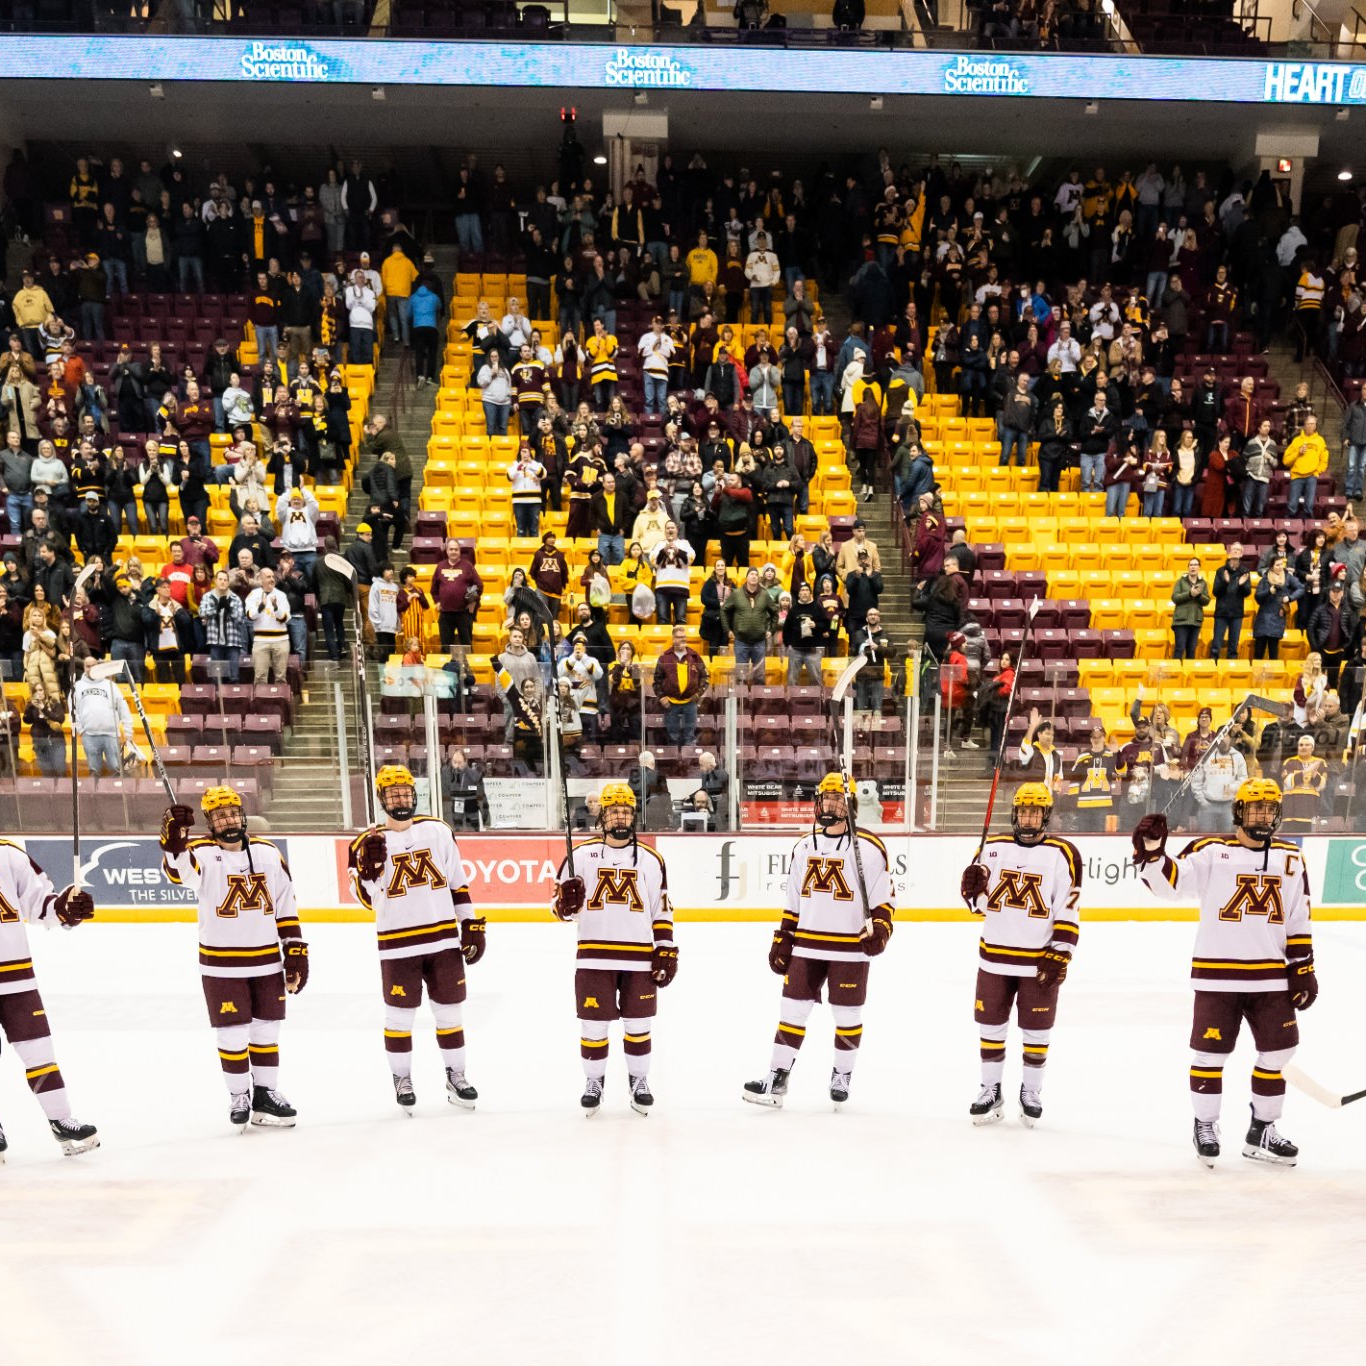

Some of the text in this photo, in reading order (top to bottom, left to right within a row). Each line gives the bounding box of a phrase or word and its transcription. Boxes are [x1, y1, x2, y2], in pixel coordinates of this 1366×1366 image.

[252, 42, 307, 62] Boston
[617, 49, 671, 69] Boston
[241, 54, 329, 79] Scientific
[605, 60, 691, 86] Scientific
[957, 57, 1010, 76] Boston
[944, 69, 1029, 94] Scientific
[1264, 63, 1348, 101] HEART
[386, 848, 447, 898] M
[1285, 854, 1300, 877] C
[587, 868, 645, 913] M
[800, 857, 855, 902] M
[129, 889, 151, 902] THE
[216, 873, 275, 919] M
[986, 869, 1051, 919] M
[1218, 874, 1285, 924] M
